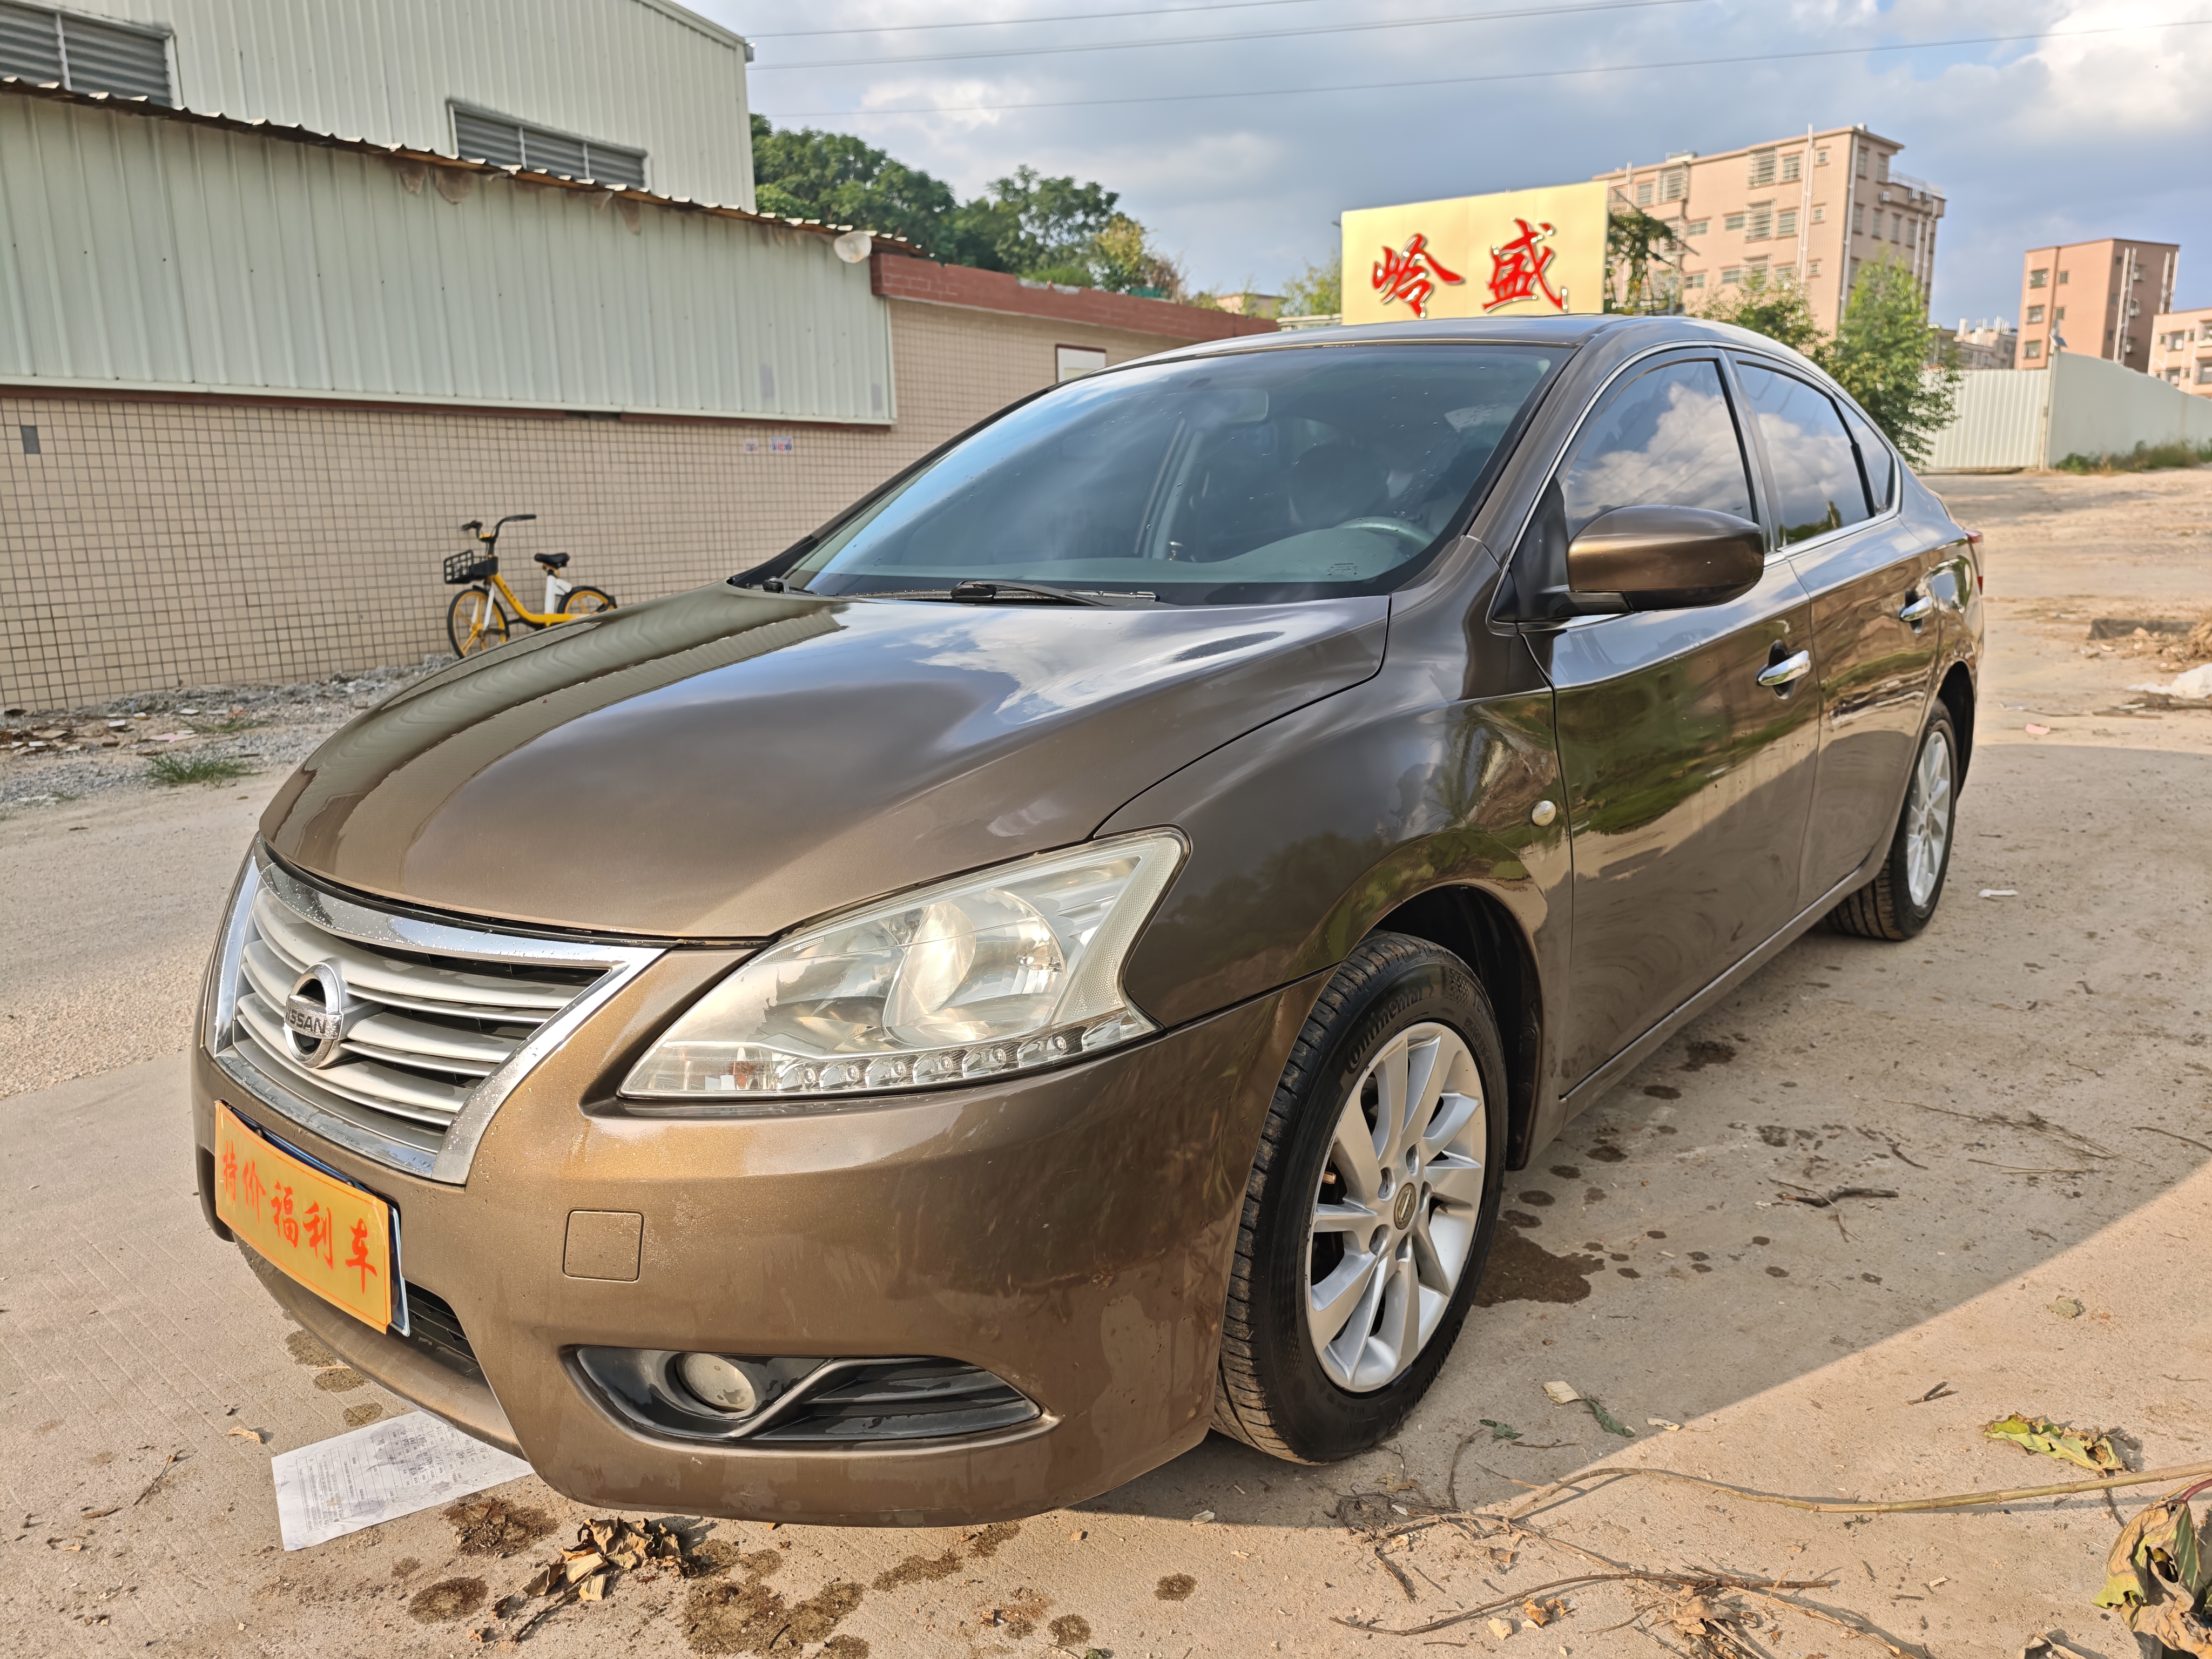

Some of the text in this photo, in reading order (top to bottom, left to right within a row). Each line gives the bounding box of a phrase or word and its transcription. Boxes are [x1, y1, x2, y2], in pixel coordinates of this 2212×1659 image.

[285, 1004, 327, 1034] NISSAN
[1347, 984, 1424, 1075] Continental
[222, 1139, 377, 1294] 特价福利车
